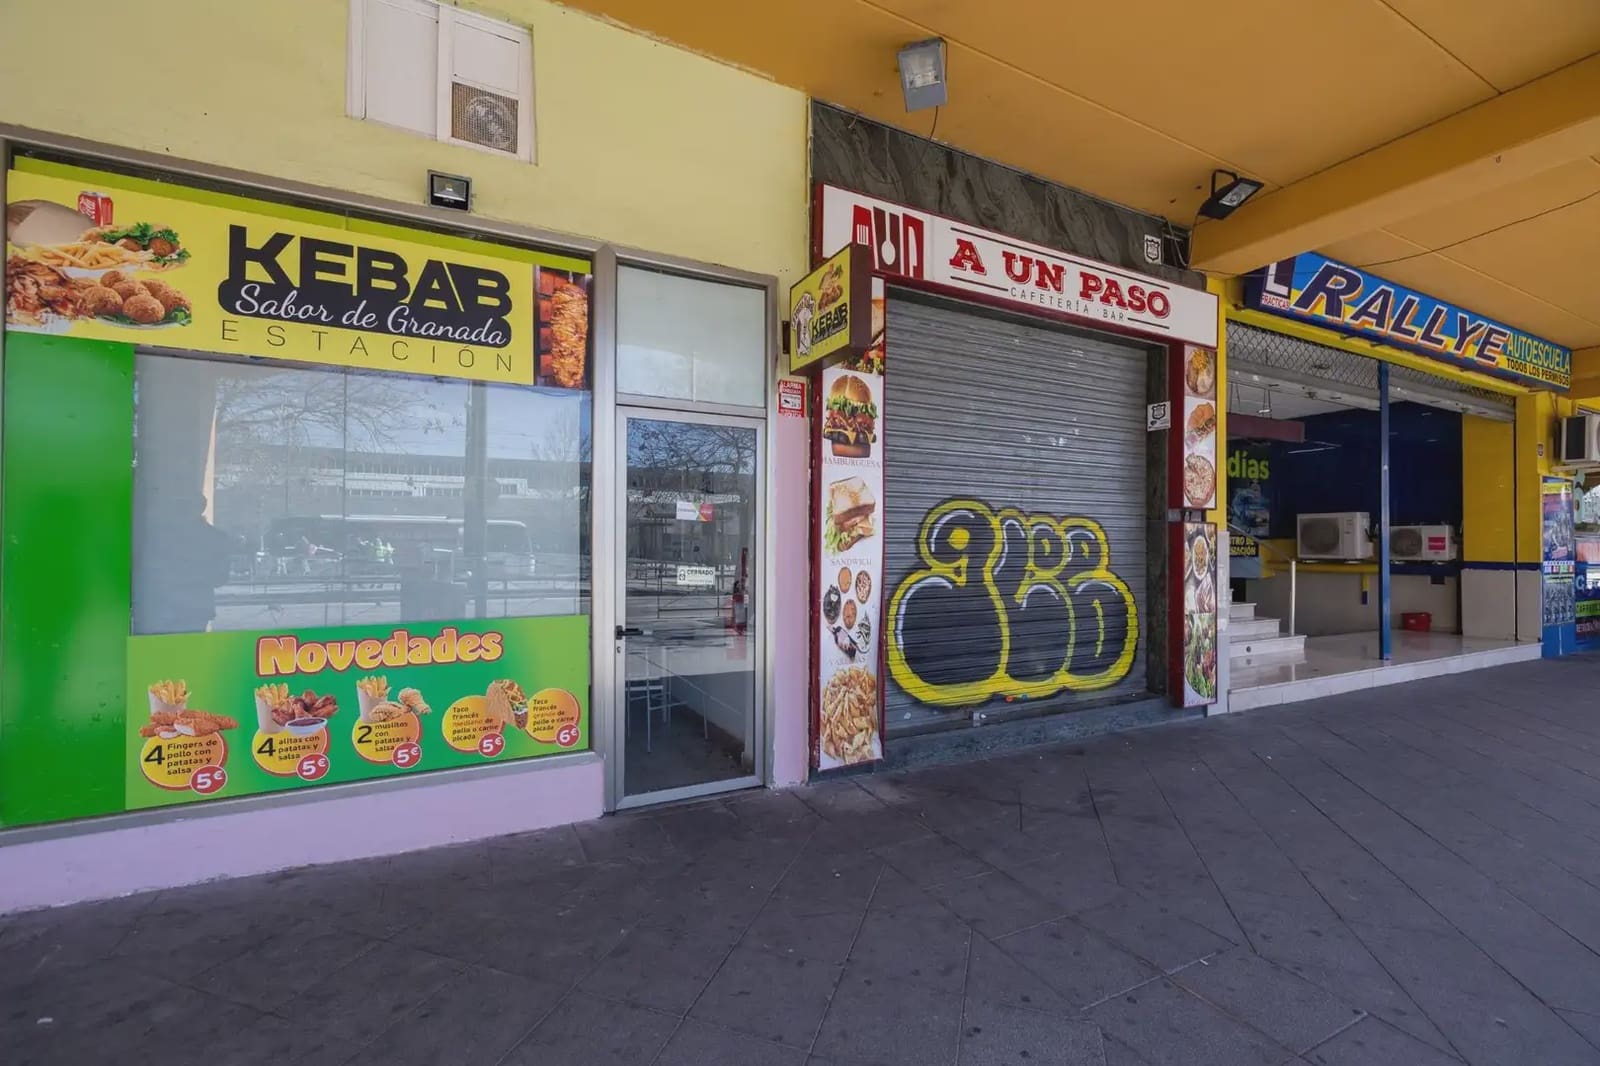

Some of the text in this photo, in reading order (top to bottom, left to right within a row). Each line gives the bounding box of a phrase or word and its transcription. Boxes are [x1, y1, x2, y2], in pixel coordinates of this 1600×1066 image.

[229, 224, 512, 318] KEBAB
[949, 238, 1171, 319] A UN PASO
[1010, 287, 1126, 321] CAFETERÍA BAR
[235, 284, 507, 346] Sabor de Granada
[812, 302, 848, 339] KEBAB
[1290, 260, 1512, 369] RALLYE
[222, 319, 513, 373] ESTACIÓN
[1507, 332, 1571, 374] AUTOESCUELA
[1507, 358, 1570, 387] TODOS LOS PERMISOS
[1227, 450, 1270, 479] días
[831, 558, 872, 567] SANDWICH
[256, 627, 503, 676] Novedades
[278, 737, 303, 745] alitas
[357, 725, 372, 744] 2
[375, 737, 404, 745] patatas
[560, 727, 578, 743] 6€
[167, 741, 203, 750] Fingers
[257, 737, 276, 757] 4
[278, 745, 311, 753] patatas
[482, 736, 502, 753] 5€
[144, 745, 165, 765] 4
[167, 751, 192, 760] pollo
[167, 758, 203, 768] patatas
[397, 747, 419, 764] 5€
[302, 758, 327, 776] 5€
[197, 770, 223, 789] 5€
